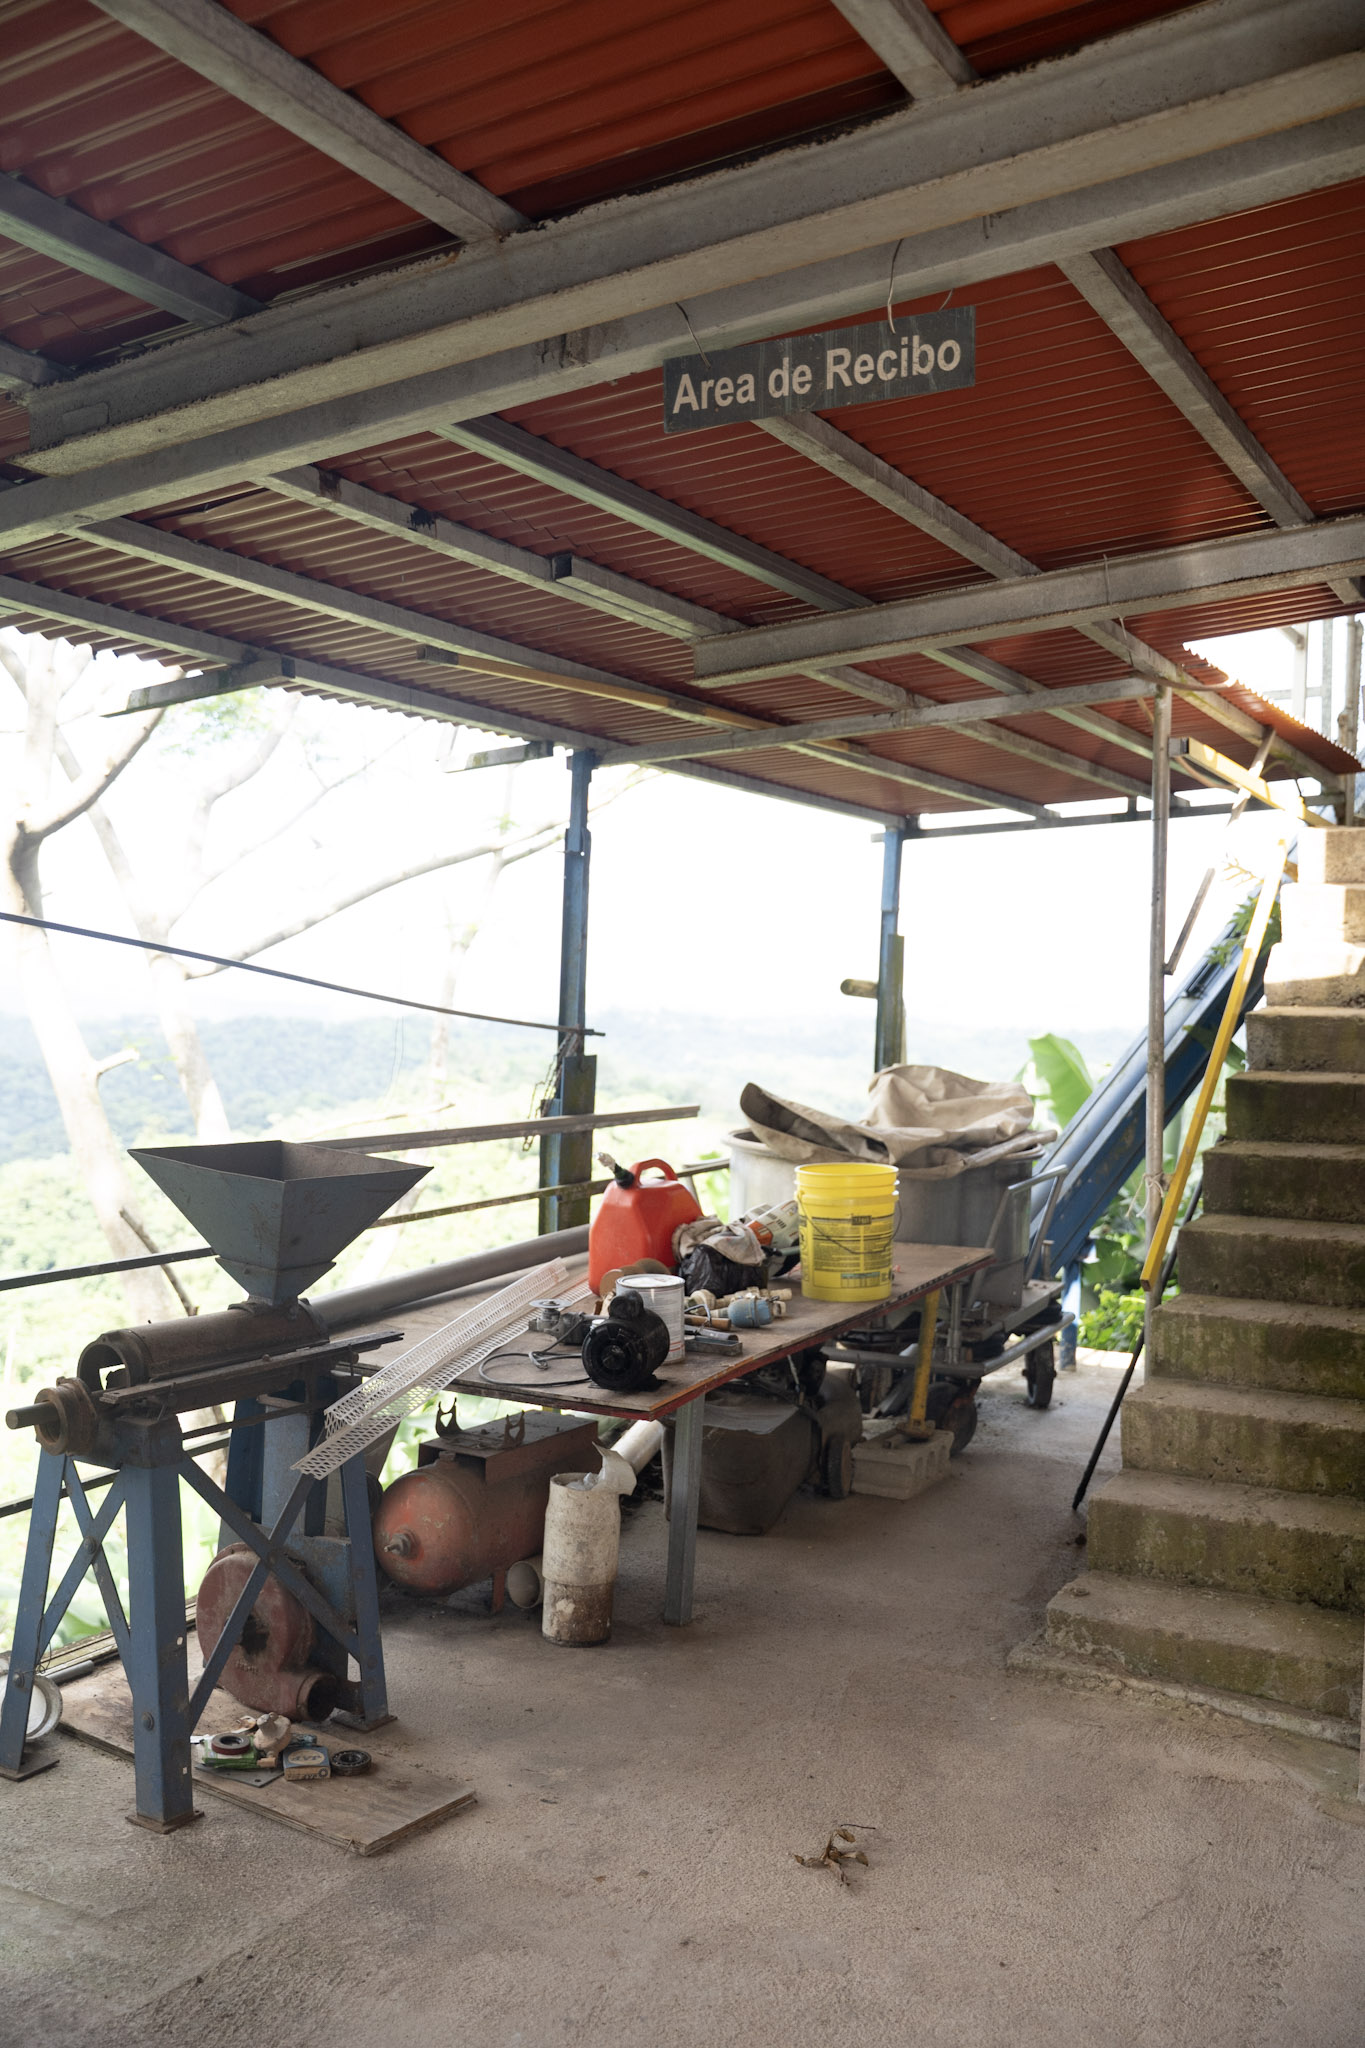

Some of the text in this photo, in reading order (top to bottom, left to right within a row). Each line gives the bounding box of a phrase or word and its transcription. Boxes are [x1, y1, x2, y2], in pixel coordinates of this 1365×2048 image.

[672, 335, 961, 414] Area de Recibo
